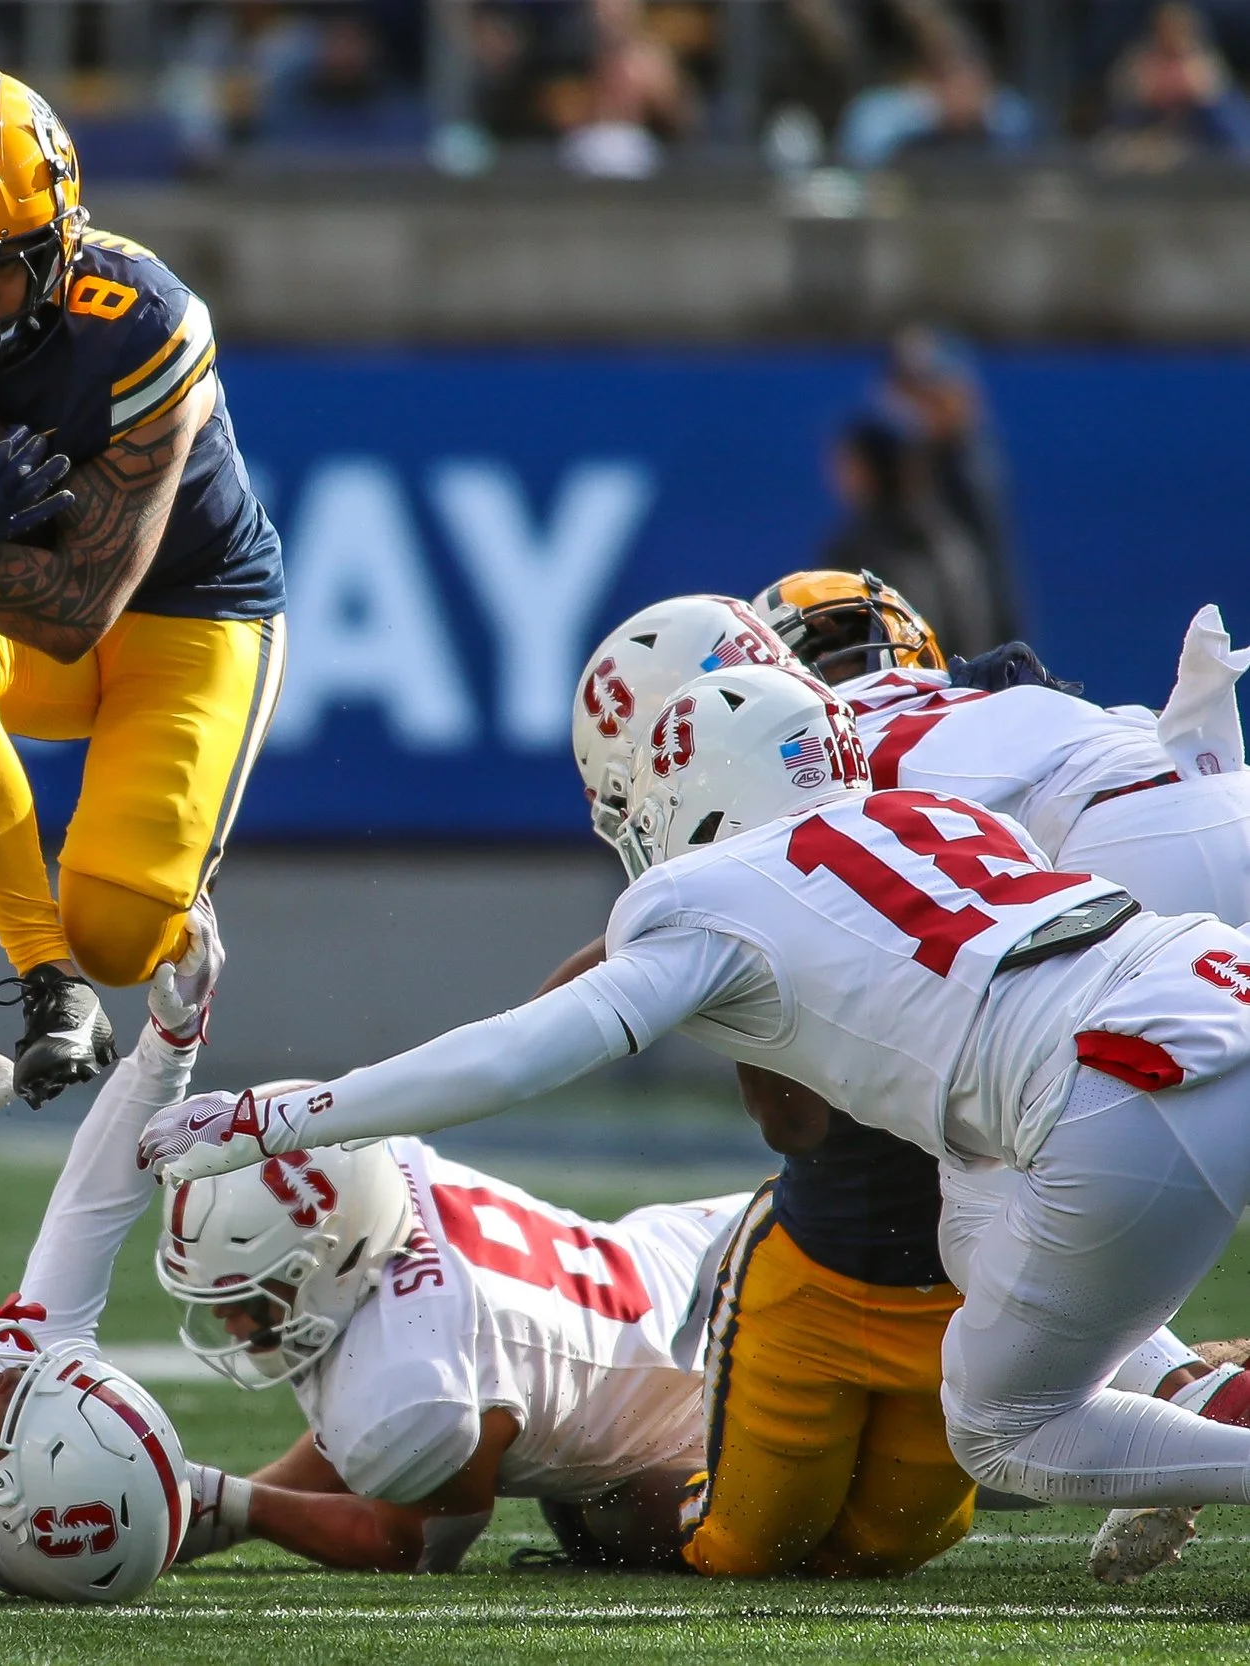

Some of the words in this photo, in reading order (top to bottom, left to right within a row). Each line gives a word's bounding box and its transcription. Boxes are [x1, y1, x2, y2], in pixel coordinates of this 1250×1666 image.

[69, 275, 138, 320] 8
[786, 790, 1092, 979] 18
[430, 1183, 654, 1324] 8
